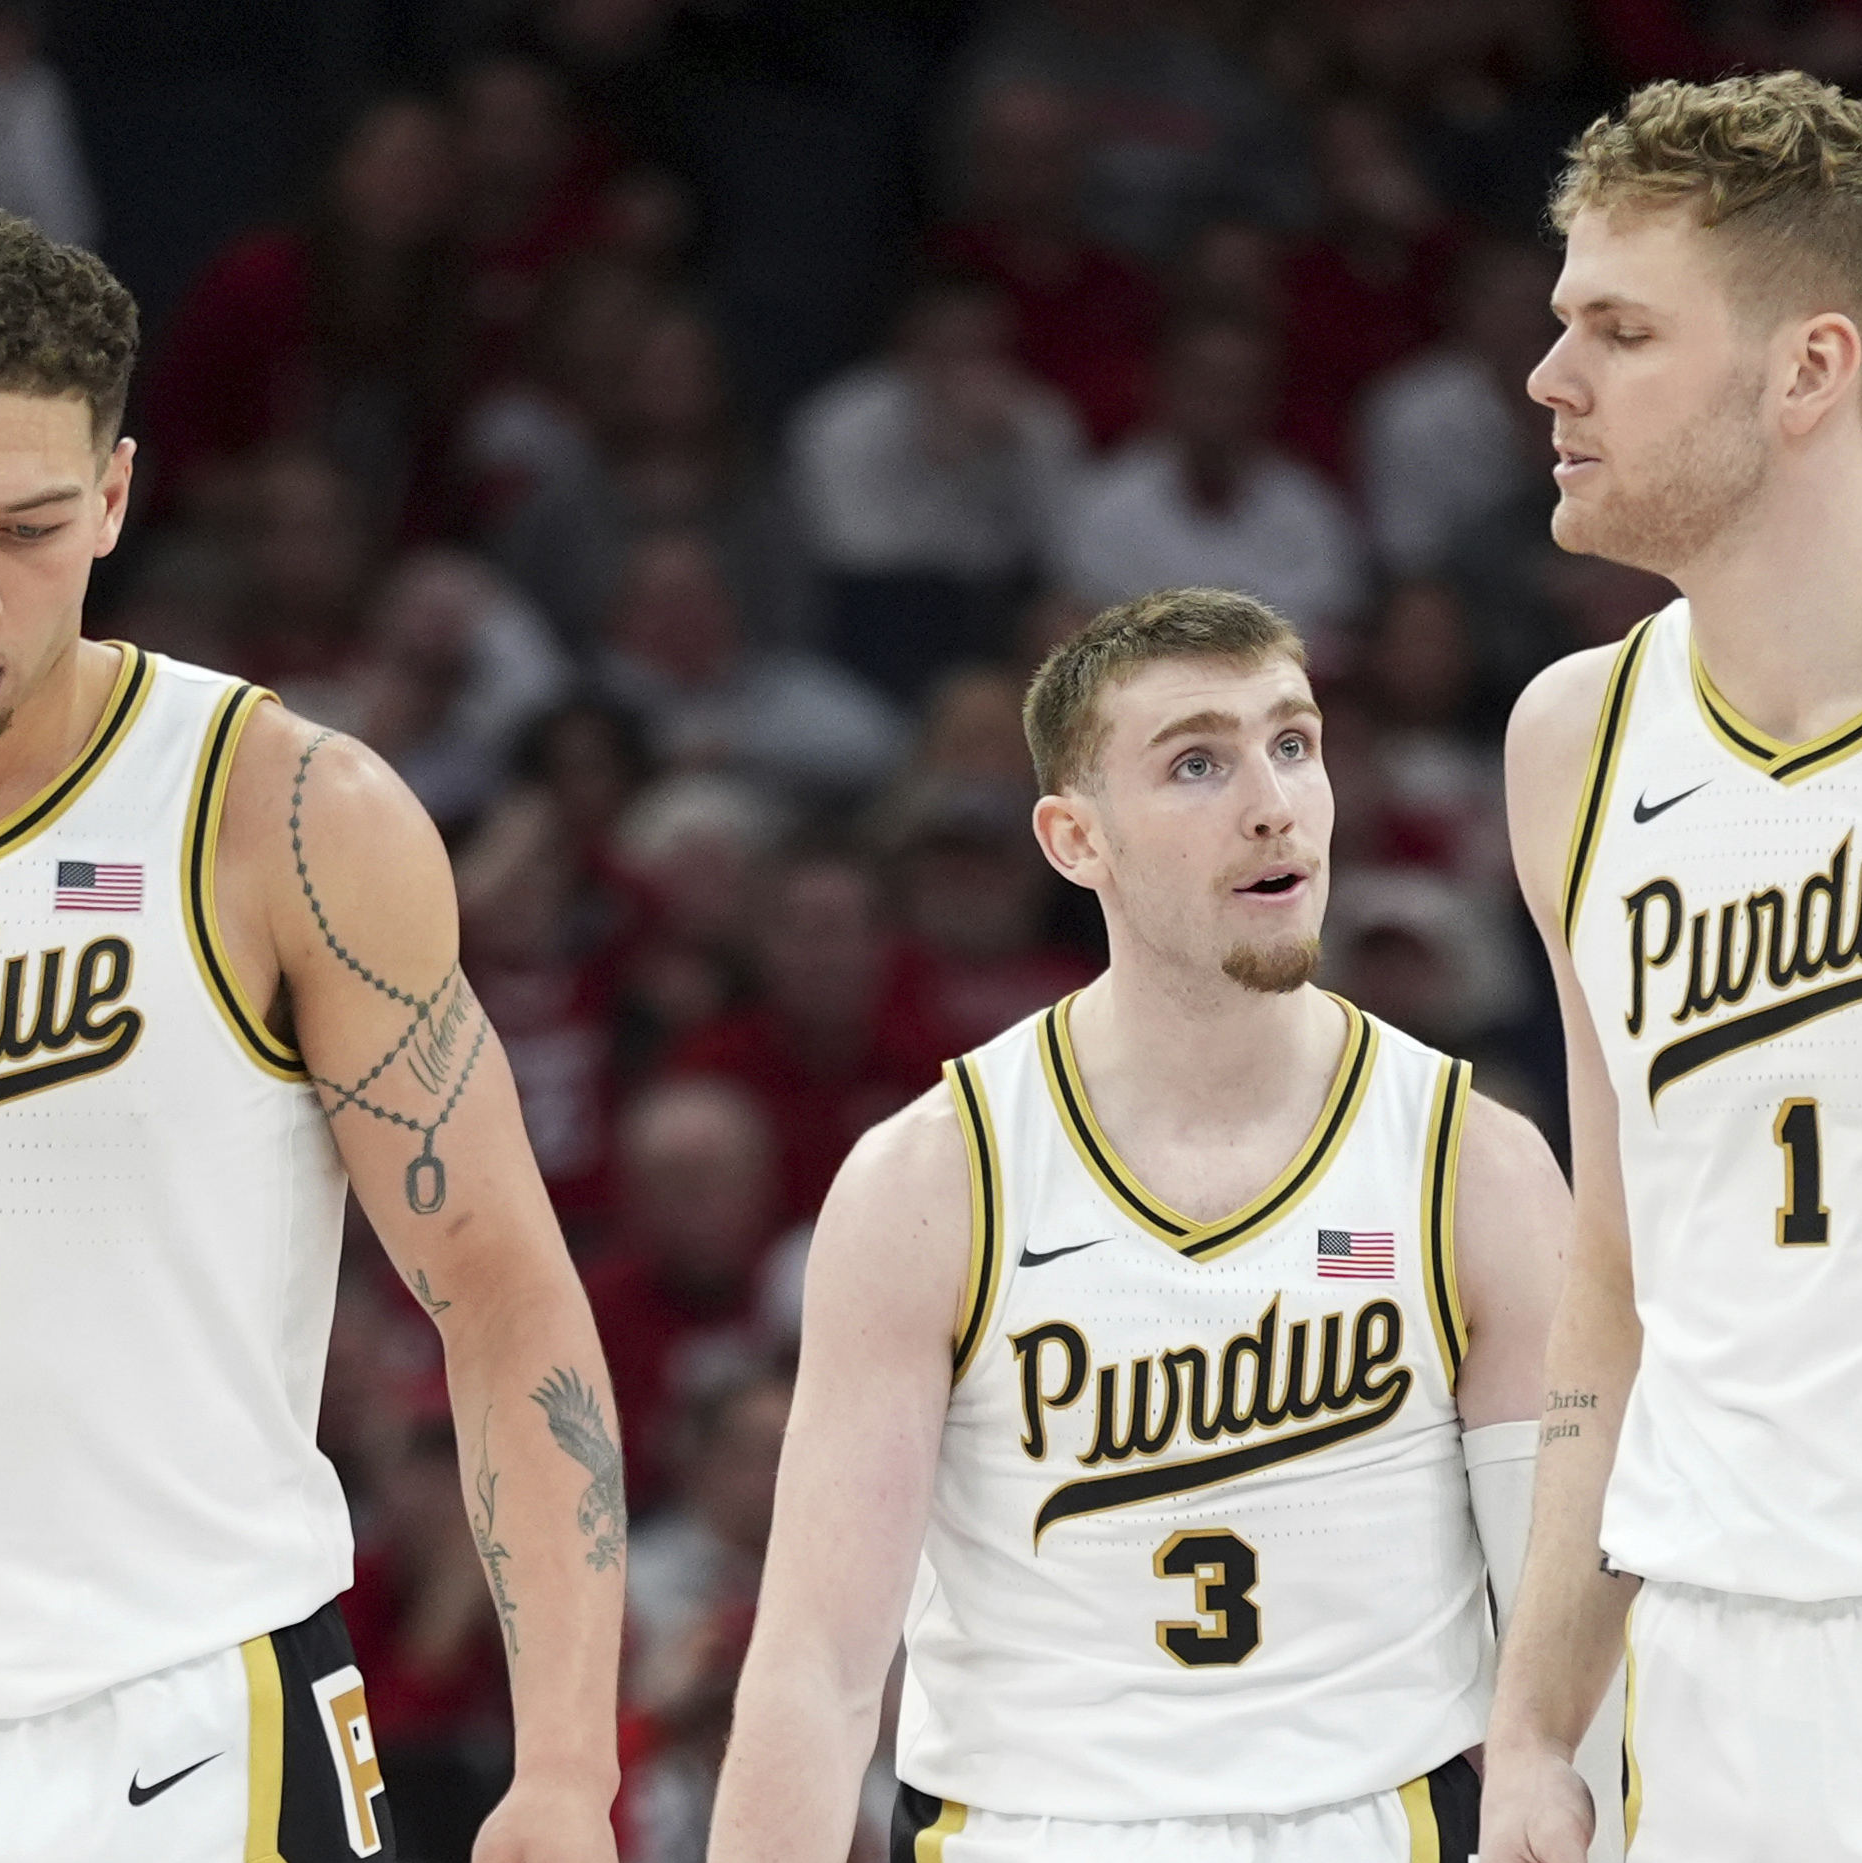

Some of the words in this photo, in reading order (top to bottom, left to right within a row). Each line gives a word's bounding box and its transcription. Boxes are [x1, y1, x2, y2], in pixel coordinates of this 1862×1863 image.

[1773, 1096, 1831, 1248] 1
[1006, 1289, 1414, 1467] Purdue
[1542, 1419, 1580, 1447] gain
[1152, 1527, 1263, 1669] 3
[311, 1663, 386, 1860] P
